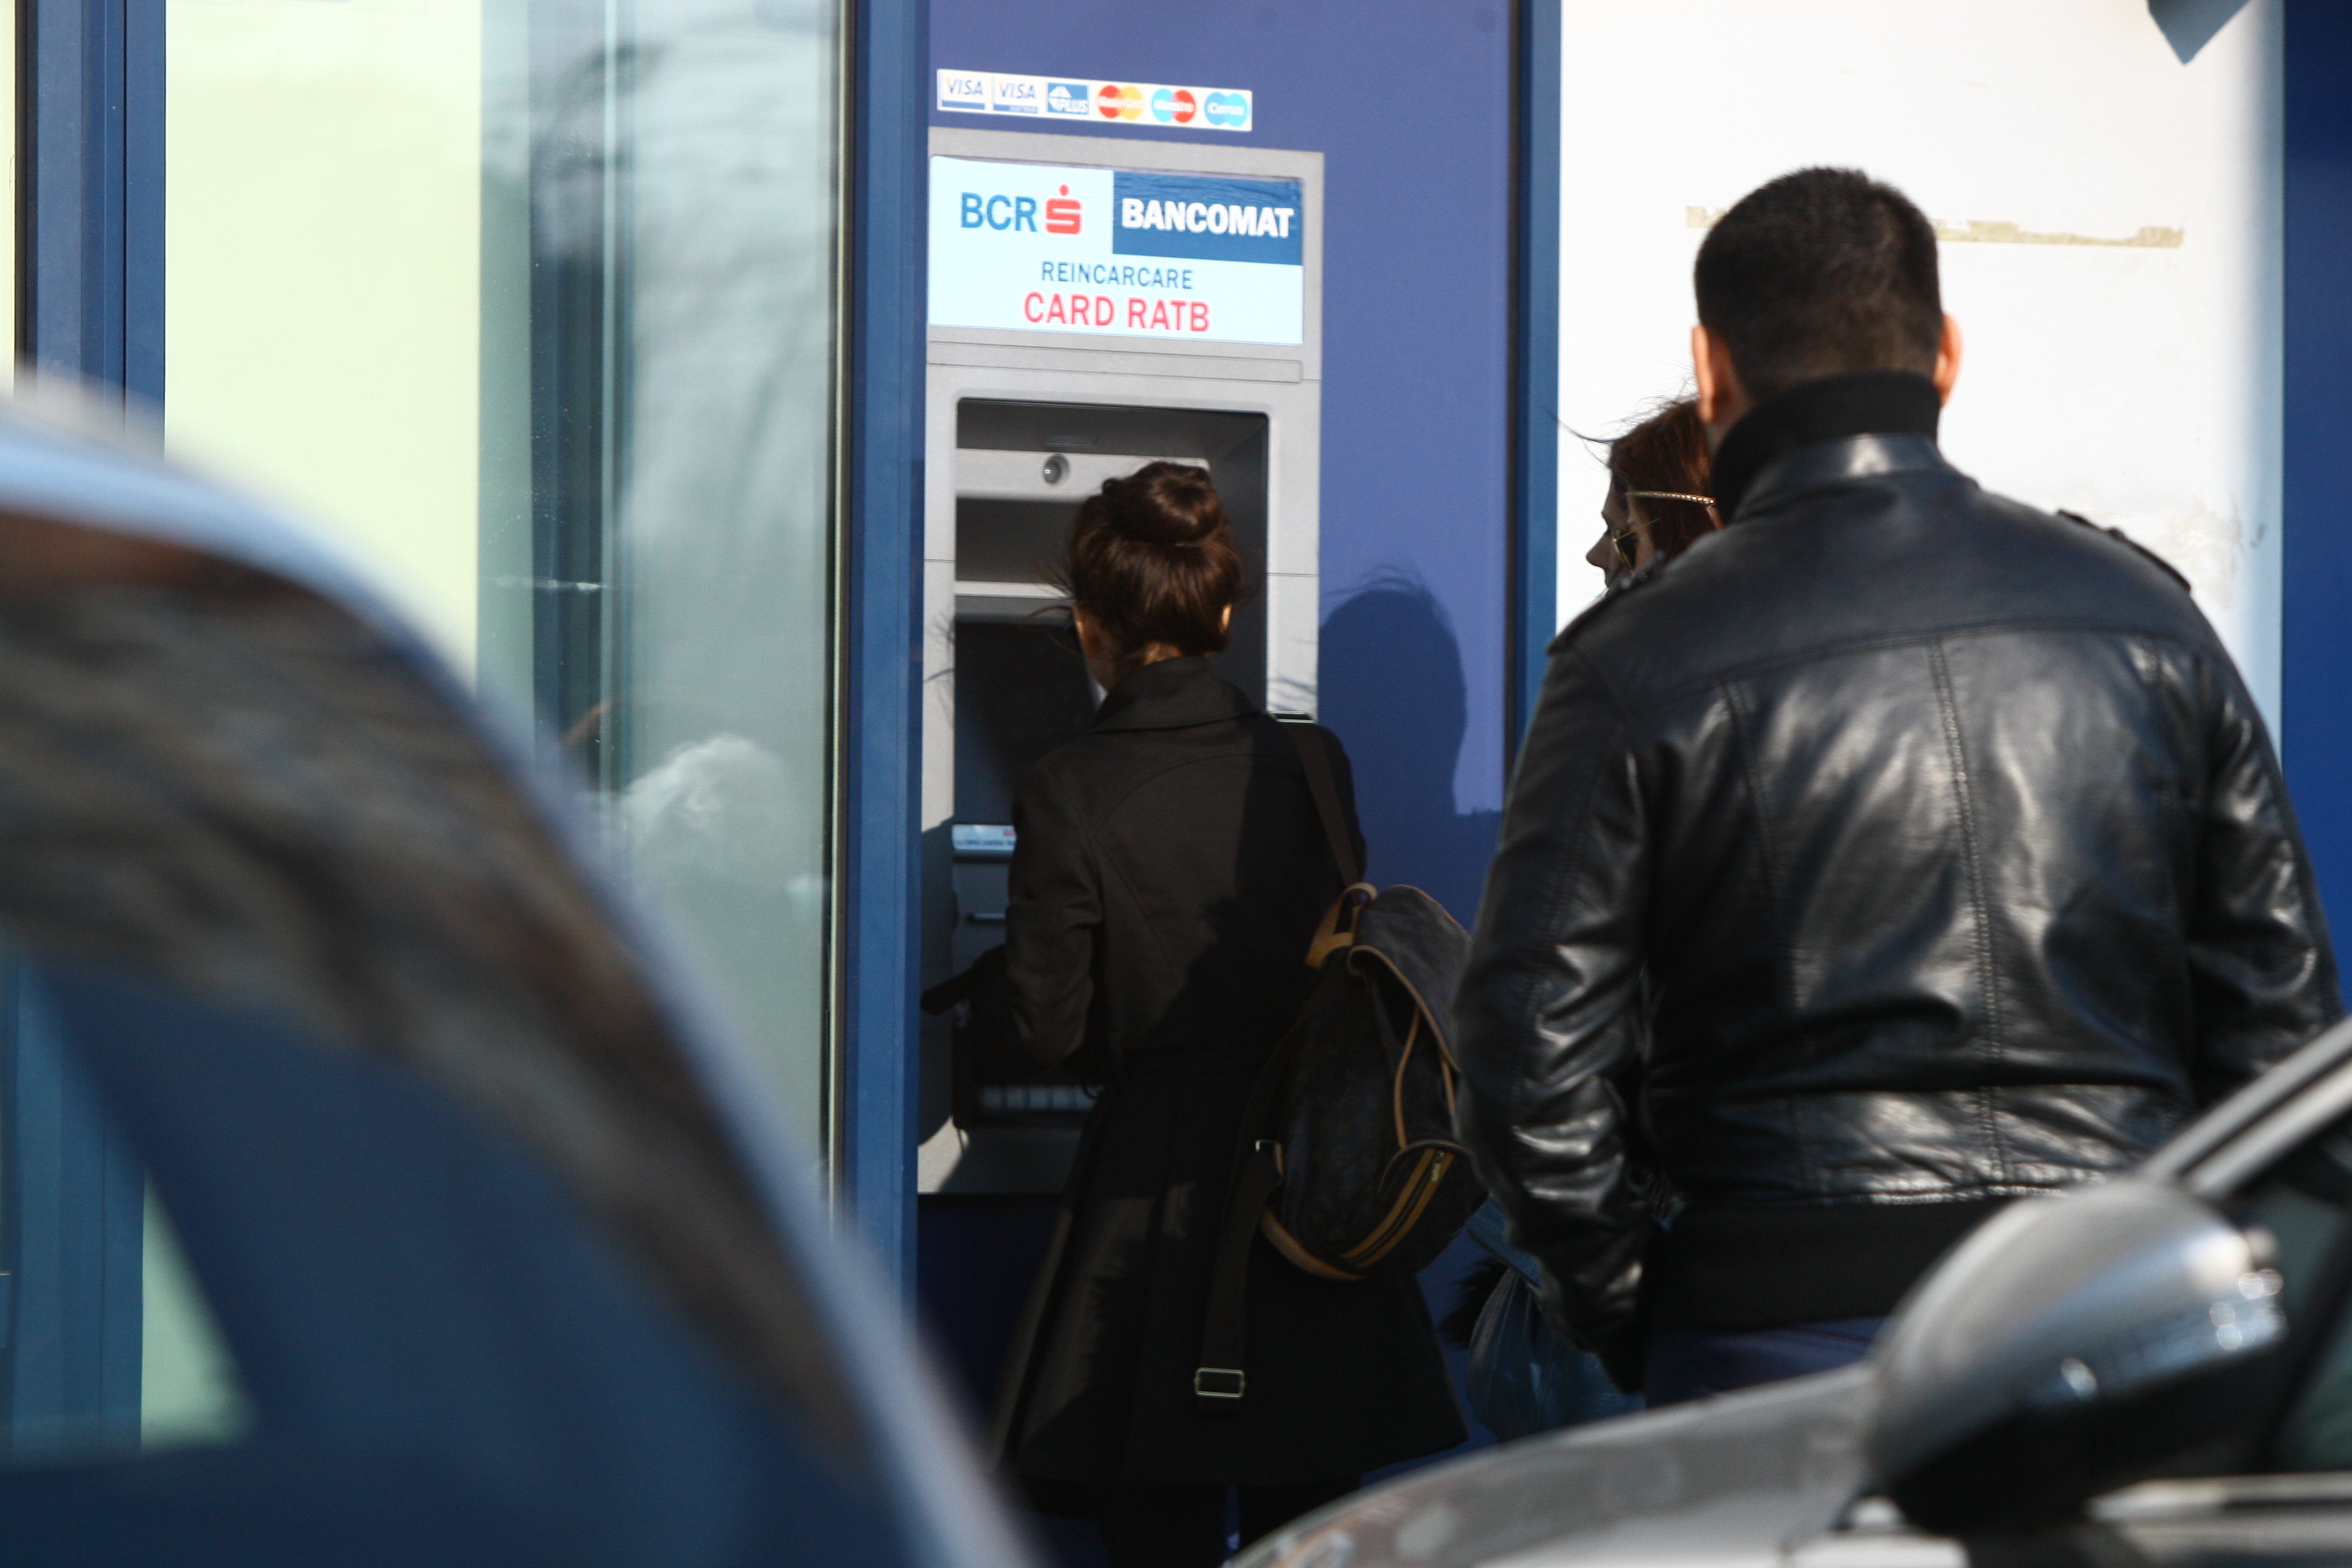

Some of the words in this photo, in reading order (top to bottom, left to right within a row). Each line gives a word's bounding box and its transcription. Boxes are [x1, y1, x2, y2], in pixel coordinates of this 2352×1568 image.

[961, 191, 1038, 232] BCR
[1121, 198, 1295, 238] BANCOMAT
[1042, 261, 1194, 289] REINCARCARE
[1024, 291, 1114, 326] CARD
[1127, 296, 1210, 332] RATB
